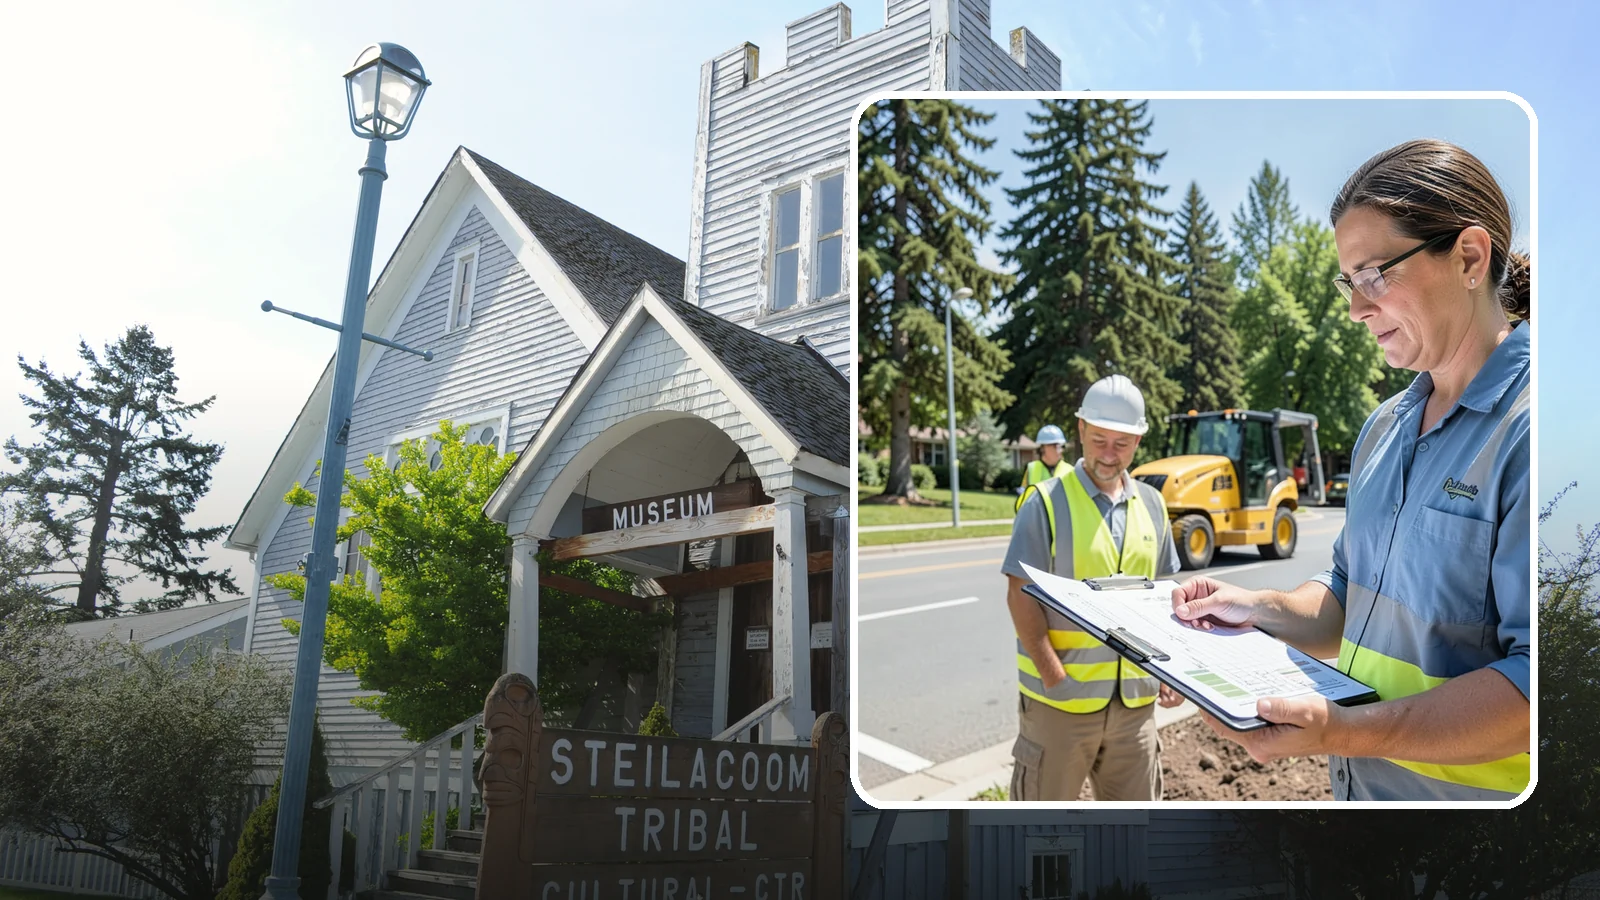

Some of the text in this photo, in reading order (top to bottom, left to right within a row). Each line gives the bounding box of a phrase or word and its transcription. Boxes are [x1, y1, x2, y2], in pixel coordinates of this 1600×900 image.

[613, 491, 713, 531] MUSEUM
[550, 738, 810, 793] STEILACOOM
[615, 806, 757, 851] TRIBAL
